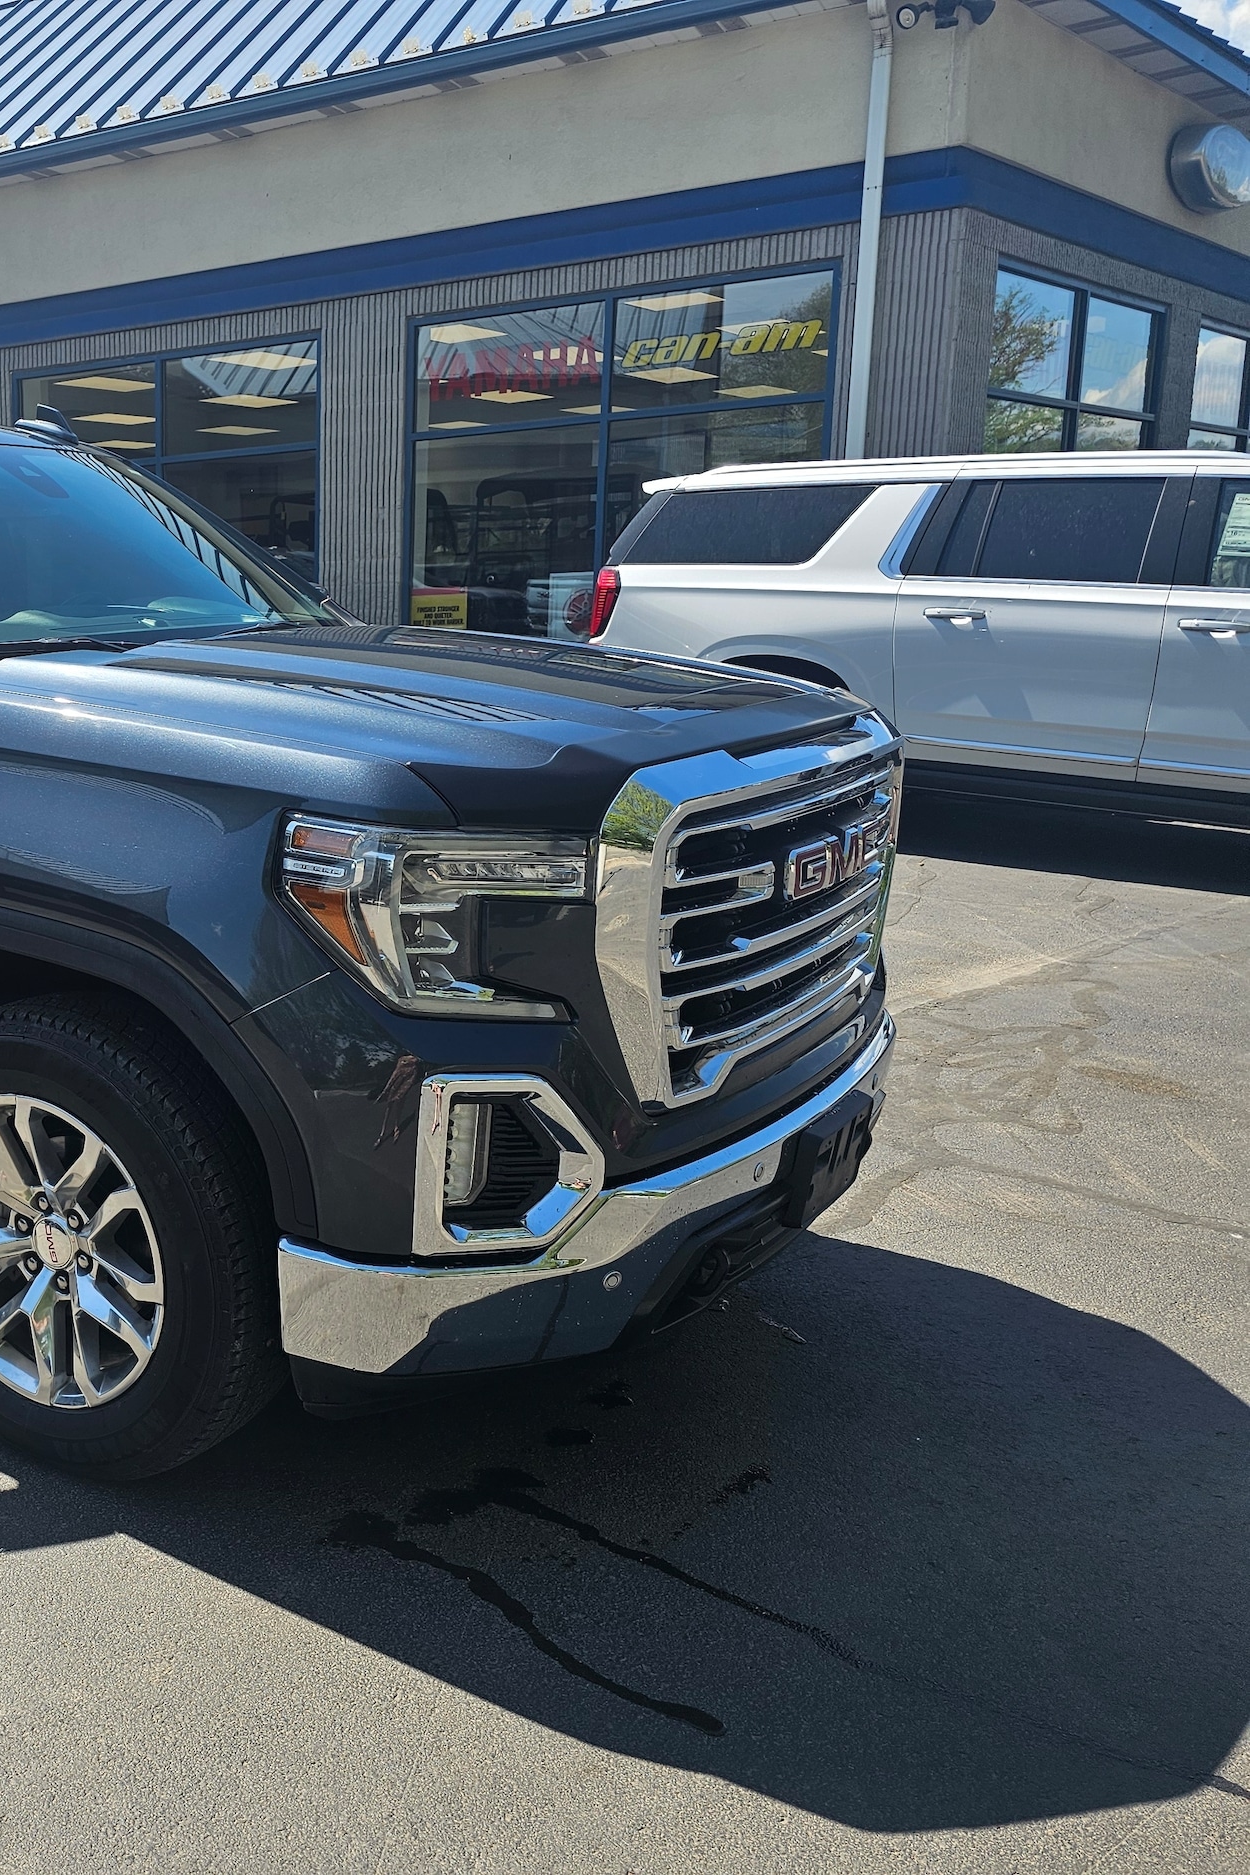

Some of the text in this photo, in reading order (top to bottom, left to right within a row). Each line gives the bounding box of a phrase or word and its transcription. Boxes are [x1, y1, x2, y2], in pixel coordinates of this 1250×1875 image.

[424, 336, 600, 400] YAMAHA
[621, 319, 823, 369] can-am
[786, 822, 887, 900] GMC
[44, 1223, 59, 1263] GMC
